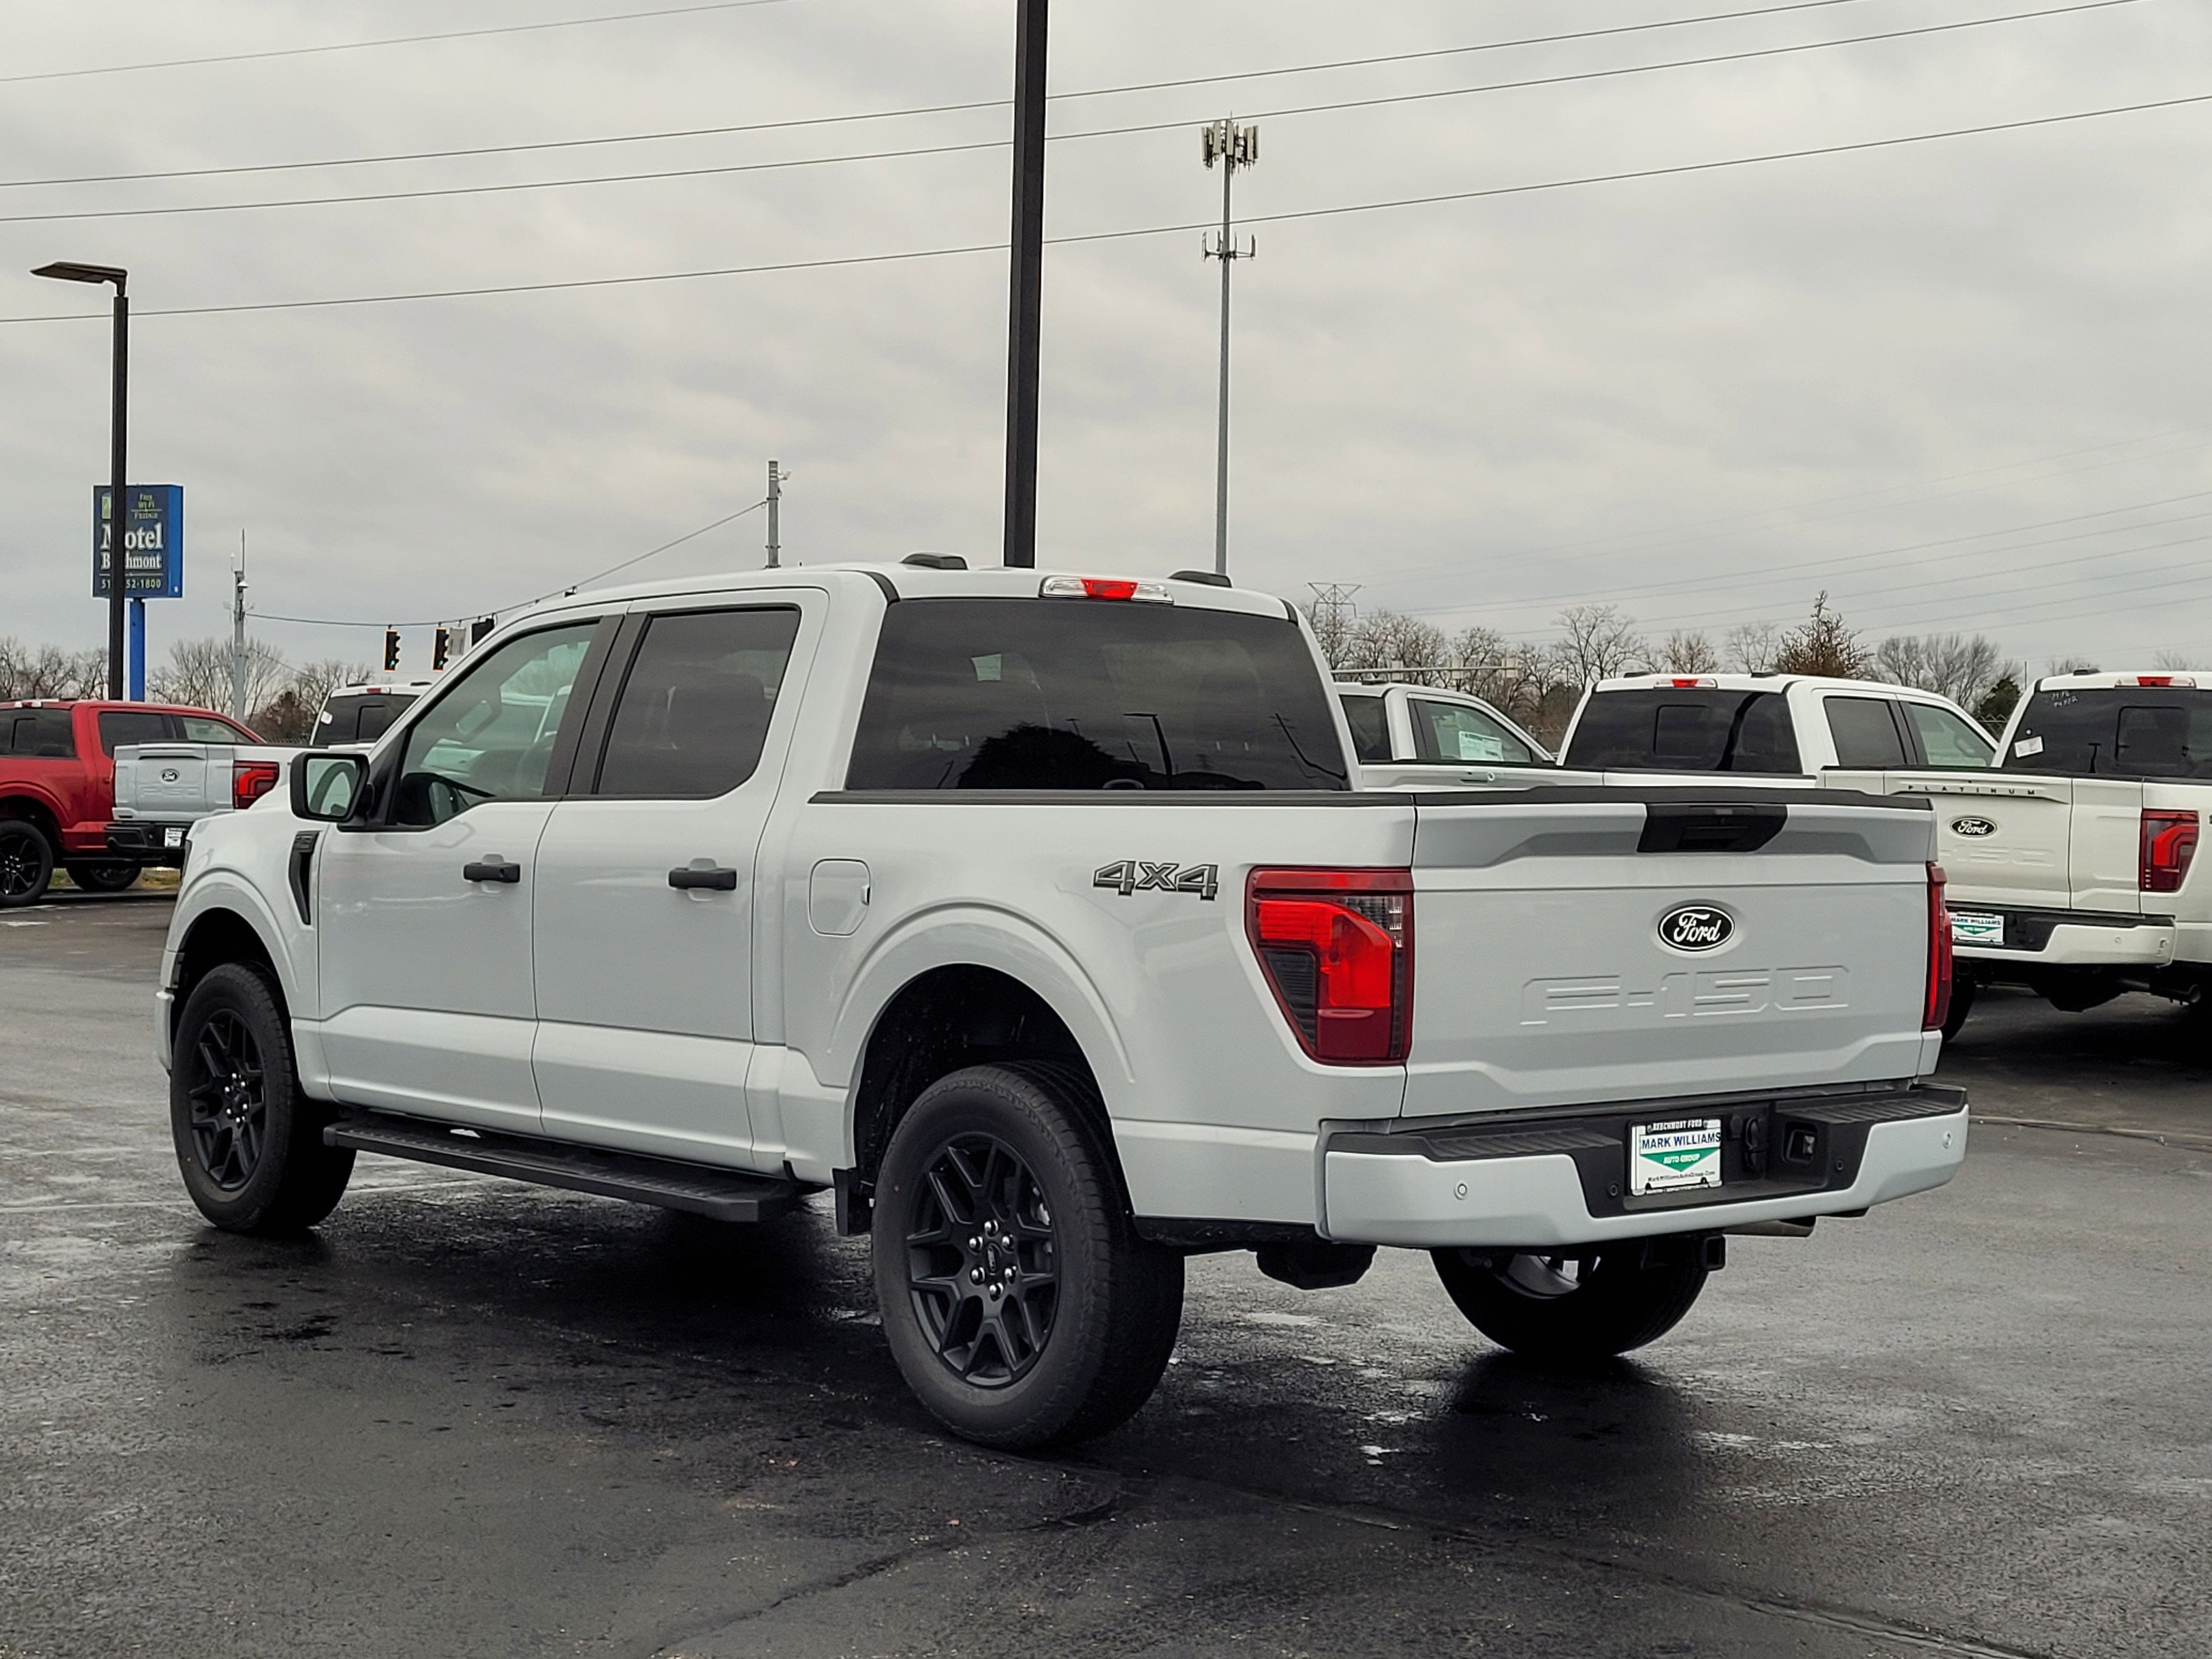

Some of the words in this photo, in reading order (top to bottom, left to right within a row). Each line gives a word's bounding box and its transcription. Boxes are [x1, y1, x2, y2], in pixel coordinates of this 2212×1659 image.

[100, 550, 162, 569] Bhmont
[1908, 785, 2035, 795] PLATINUM
[1957, 819, 1988, 834] Ford
[1673, 912, 1722, 943] Ford
[1520, 966, 1850, 1025] F-150
[1688, 1119, 1702, 1128] FORD
[1641, 1136, 1671, 1150] MARK
[1673, 1132, 1722, 1147] WILLIAMS
[1663, 1155, 1680, 1164] AUTO
[1680, 1153, 1701, 1163] GROUP
